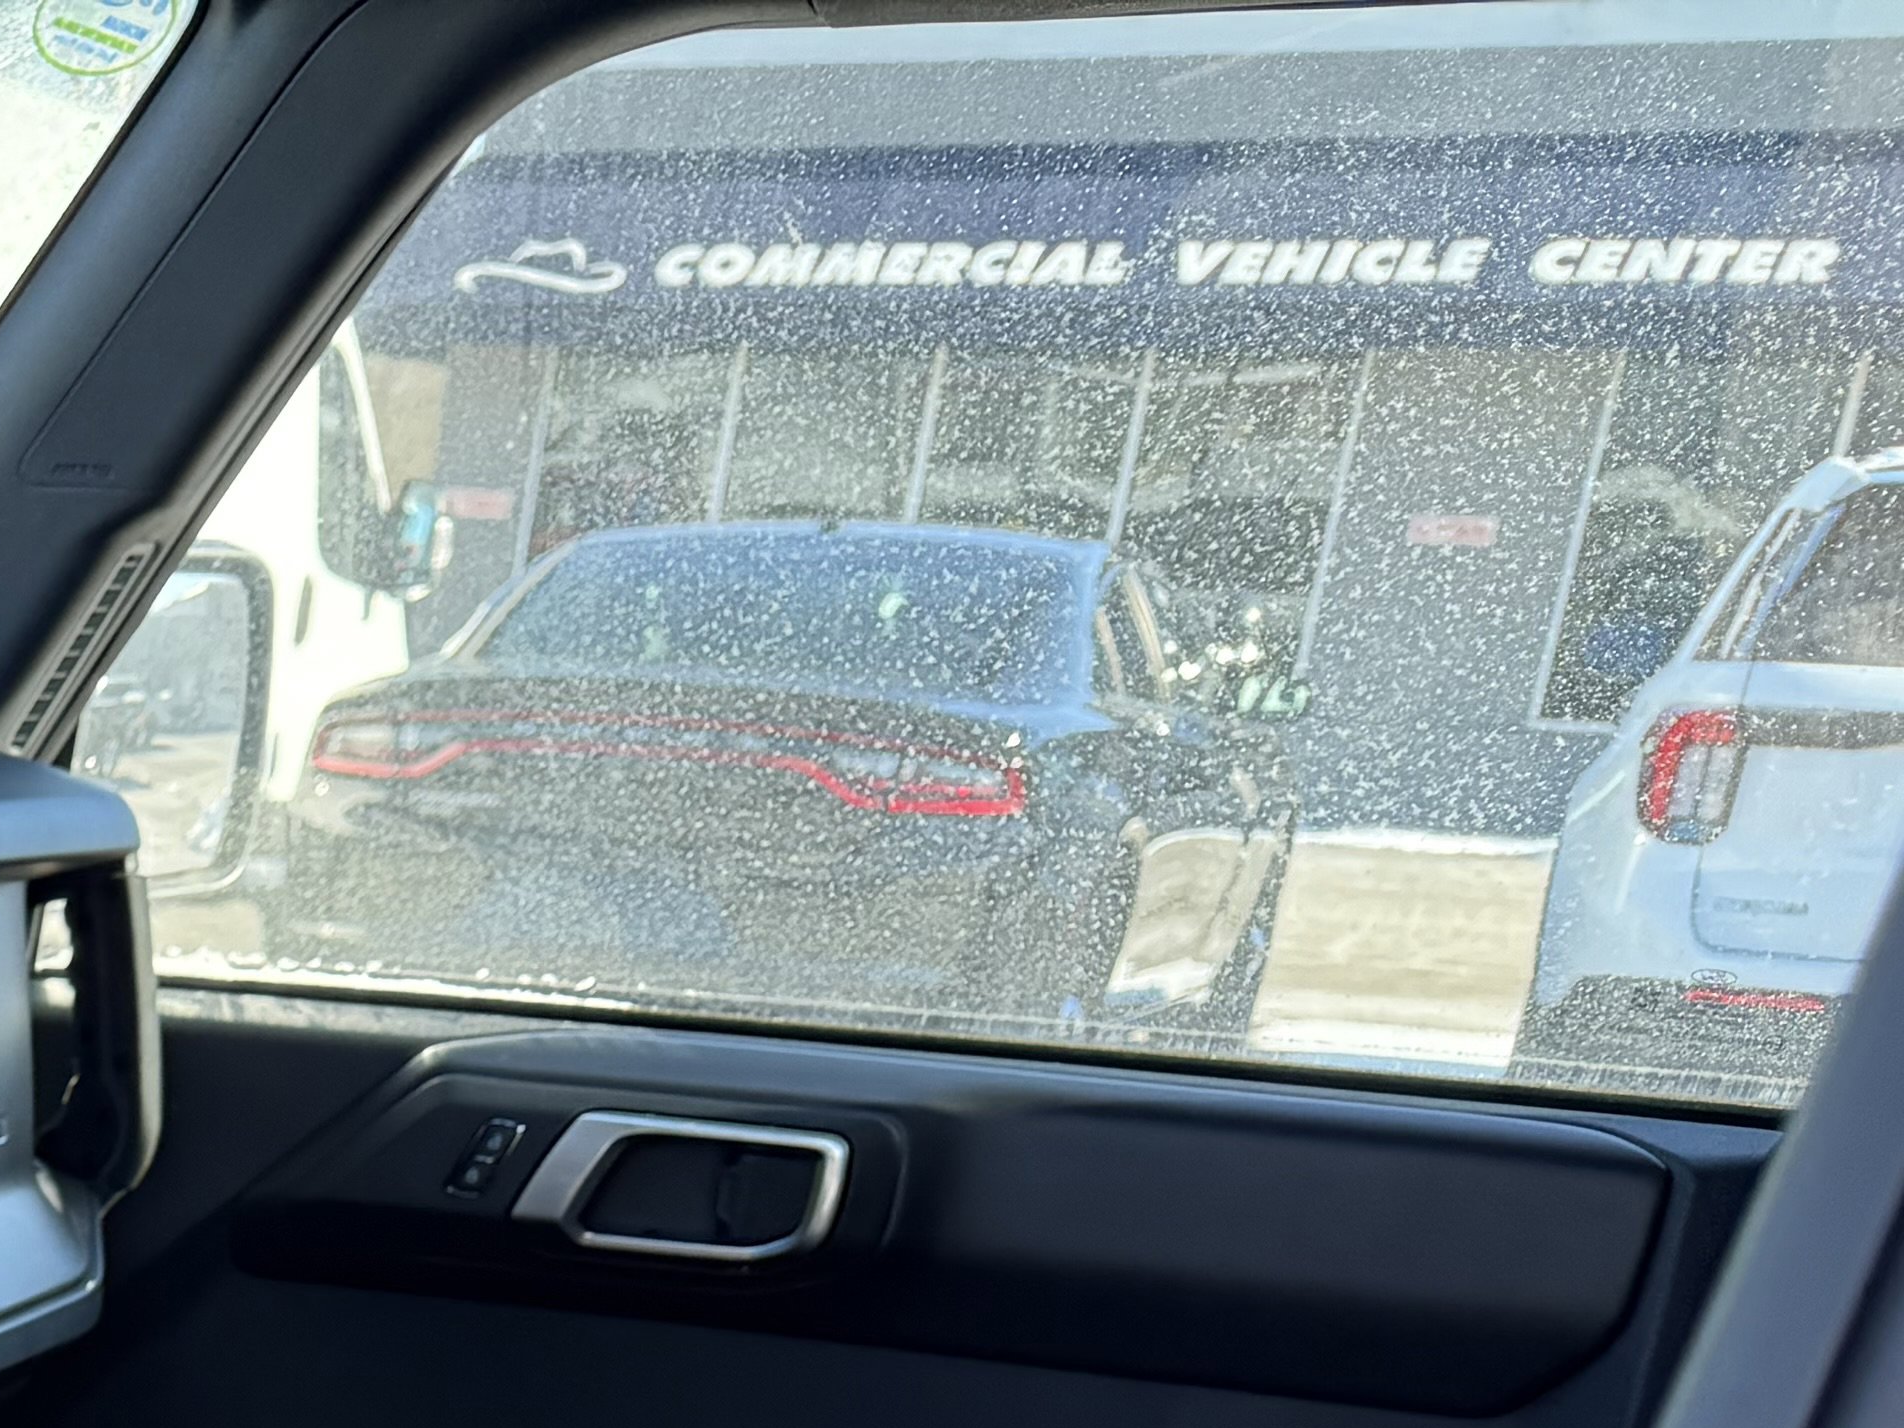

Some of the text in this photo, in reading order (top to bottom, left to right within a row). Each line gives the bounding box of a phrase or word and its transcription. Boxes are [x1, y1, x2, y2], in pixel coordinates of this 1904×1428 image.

[654, 238, 1841, 288] COMMERCIAL VEHICLE CENTER
